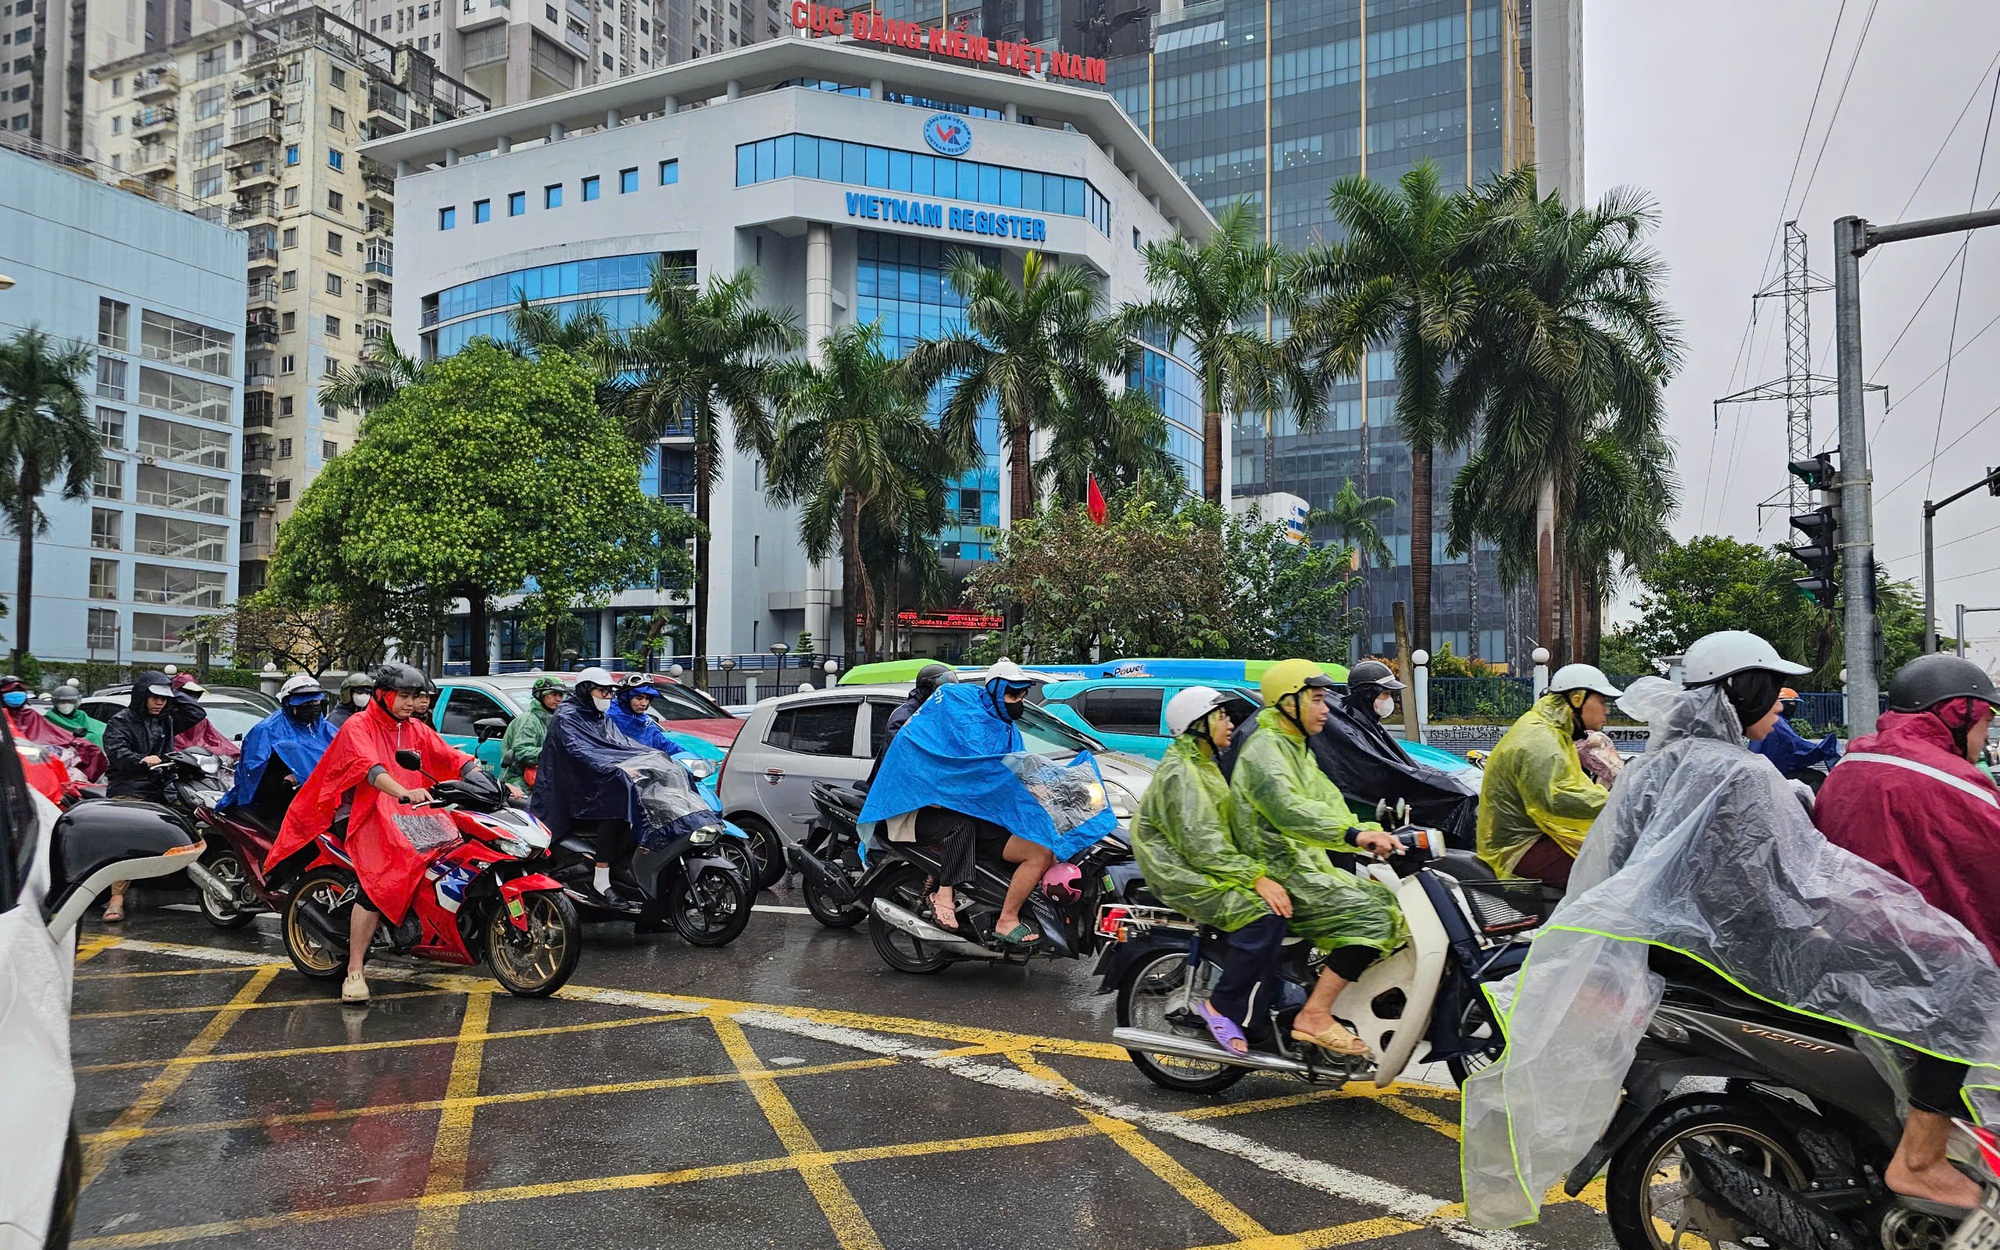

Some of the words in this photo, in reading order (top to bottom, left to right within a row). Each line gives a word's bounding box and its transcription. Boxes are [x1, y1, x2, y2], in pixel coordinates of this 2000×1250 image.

[792, 1, 844, 38] CỤC
[852, 9, 921, 50] ĐĂNG
[929, 20, 989, 64] KIỂM
[996, 37, 1045, 75] VIỆT
[1052, 51, 1107, 85] NAM
[845, 191, 943, 228] VIETNAM
[949, 206, 1047, 242] REGISTER
[1114, 664, 1144, 676] Power
